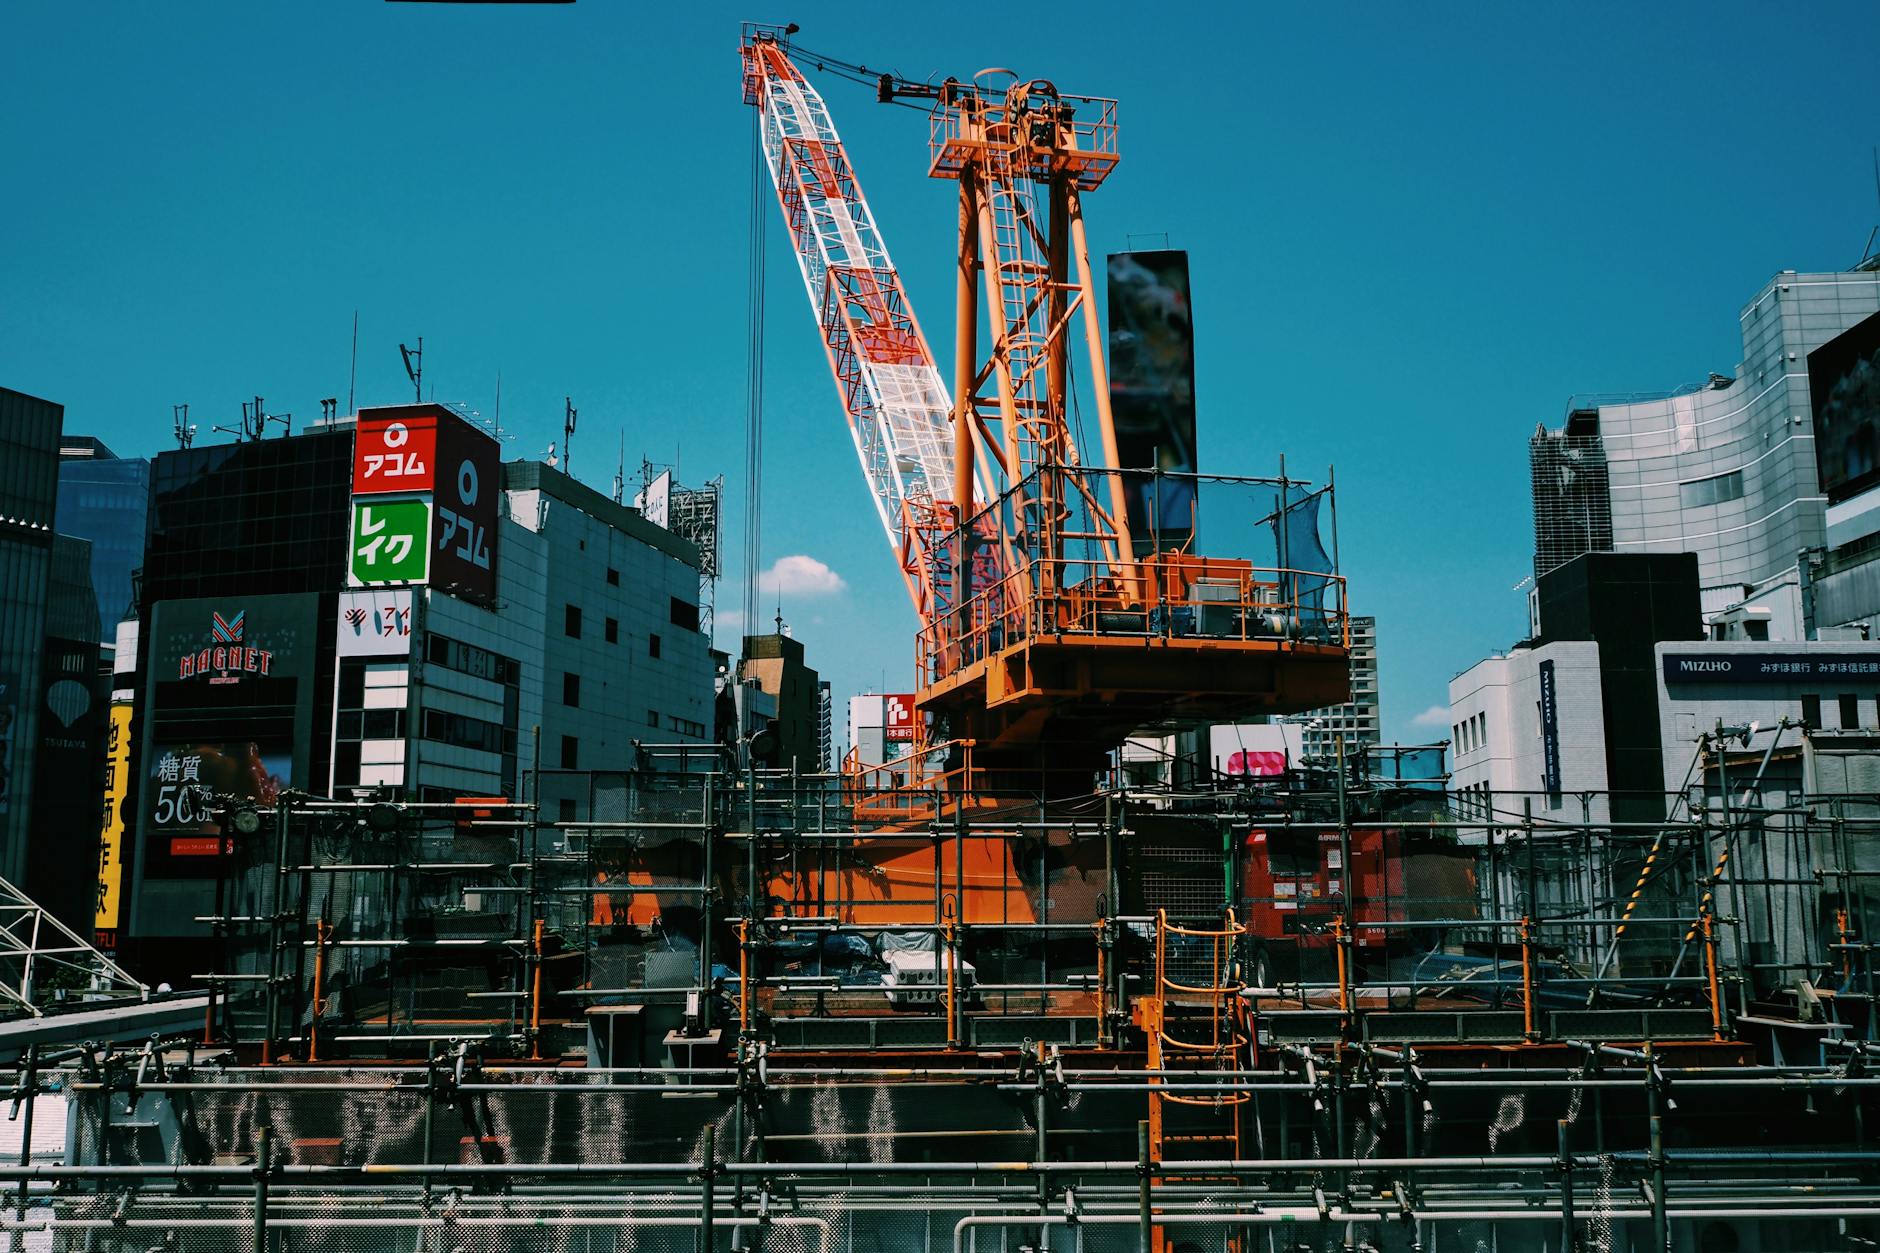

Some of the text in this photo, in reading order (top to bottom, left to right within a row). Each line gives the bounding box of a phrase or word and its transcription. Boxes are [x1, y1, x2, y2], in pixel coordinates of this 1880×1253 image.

[363, 452, 426, 479] アコム
[439, 505, 490, 571] アコム
[179, 646, 273, 680] MAGNET
[1680, 660, 1880, 673] MIZUHO みずほ銀行 みずほ信託銀
[886, 728, 913, 737] 本銀行
[157, 755, 202, 783] 糖質
